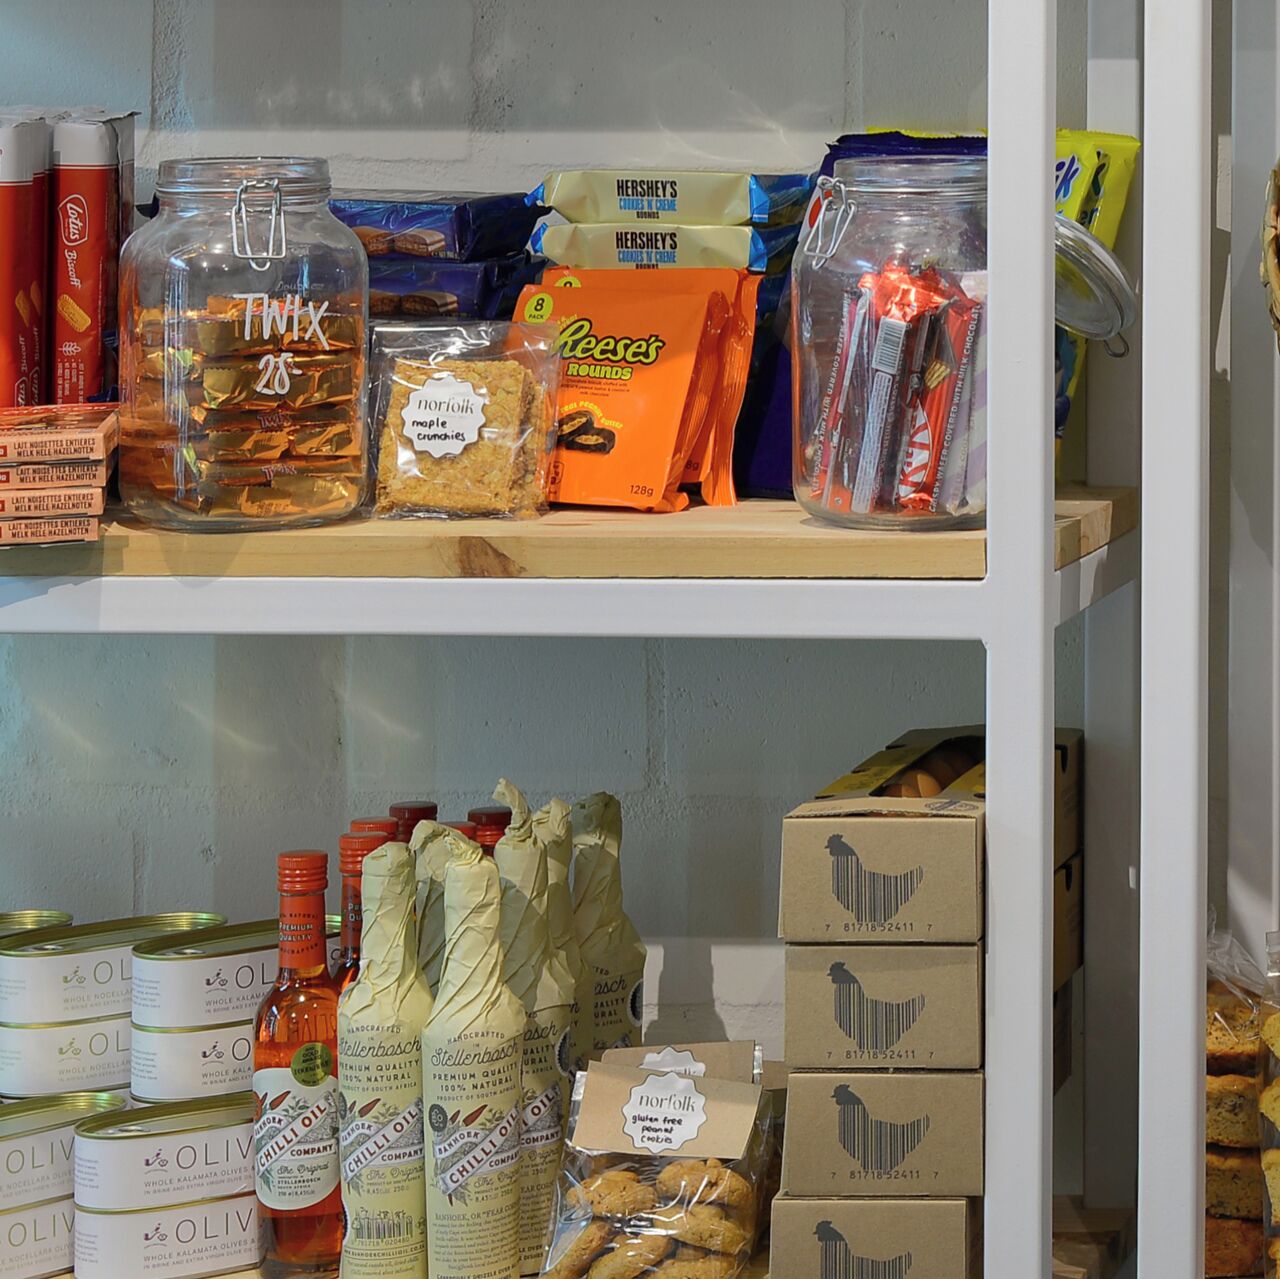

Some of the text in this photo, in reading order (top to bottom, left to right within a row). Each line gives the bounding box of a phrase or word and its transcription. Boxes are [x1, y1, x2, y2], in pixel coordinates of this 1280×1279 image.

[616, 179, 677, 198] HERSHEY'S
[63, 202, 86, 289] Lotus Biscoff
[615, 231, 677, 250] HERSHEY'S
[534, 297, 545, 312] 8
[233, 292, 329, 351] TWIX
[567, 363, 633, 380] ROUNDS
[417, 395, 475, 415] norfolk
[411, 418, 448, 431] maple
[30, 439, 63, 449] NOISETTES
[416, 430, 466, 442] crunchies
[629, 484, 654, 497] 128g
[433, 1072, 476, 1081] PREMIUM
[441, 1075, 512, 1092] 100% NATURAL
[639, 1094, 697, 1114] norfolk
[631, 1113, 683, 1127] gluten free
[259, 1105, 327, 1171] CHILLI OIL
[348, 1109, 418, 1175] CHILLI OIL
[640, 1135, 673, 1145] cookies
[290, 1144, 334, 1158] COMPANY
[381, 1149, 423, 1162] COMPANY
[450, 1141, 497, 1184] CHILLI
